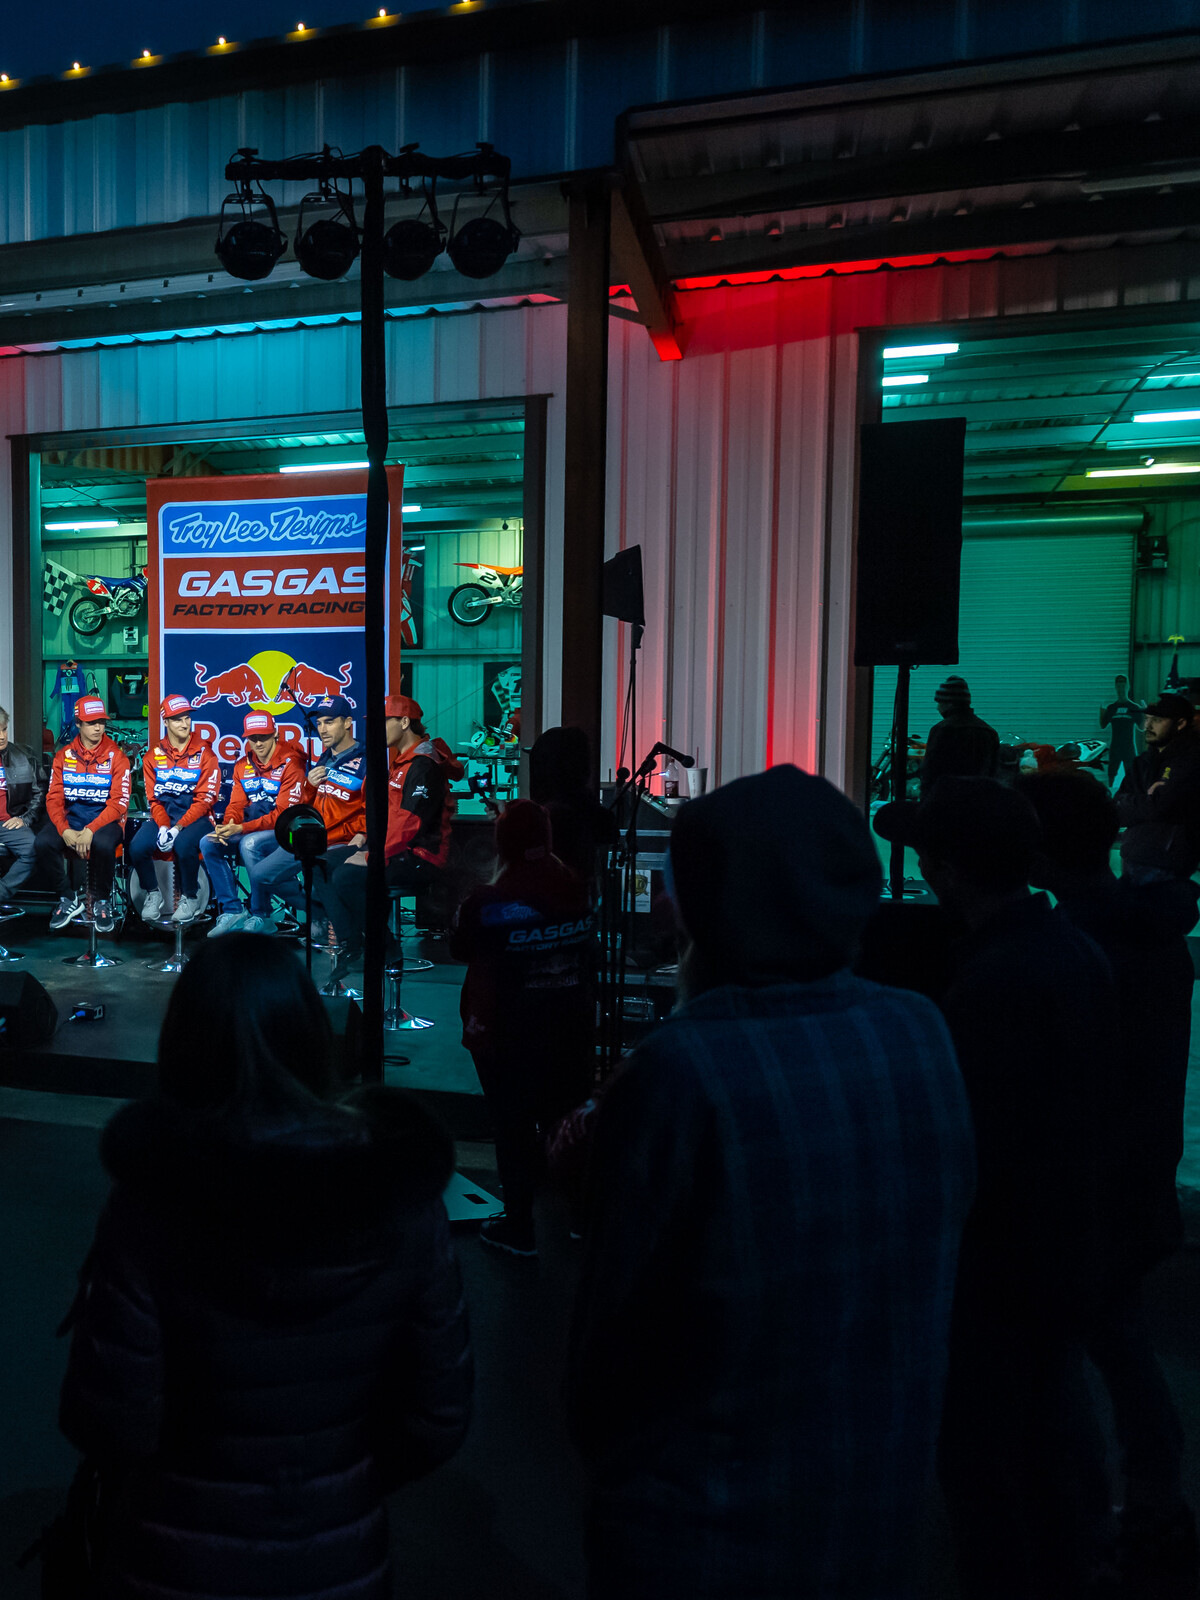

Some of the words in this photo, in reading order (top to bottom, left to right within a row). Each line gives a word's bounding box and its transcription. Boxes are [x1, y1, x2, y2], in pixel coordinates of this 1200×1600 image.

[169, 512, 223, 548] Troy
[220, 511, 269, 544] Lee
[269, 507, 366, 545] Designs
[177, 566, 366, 597] GASGAS
[173, 603, 274, 616] FACTORY
[278, 601, 365, 615] RACING
